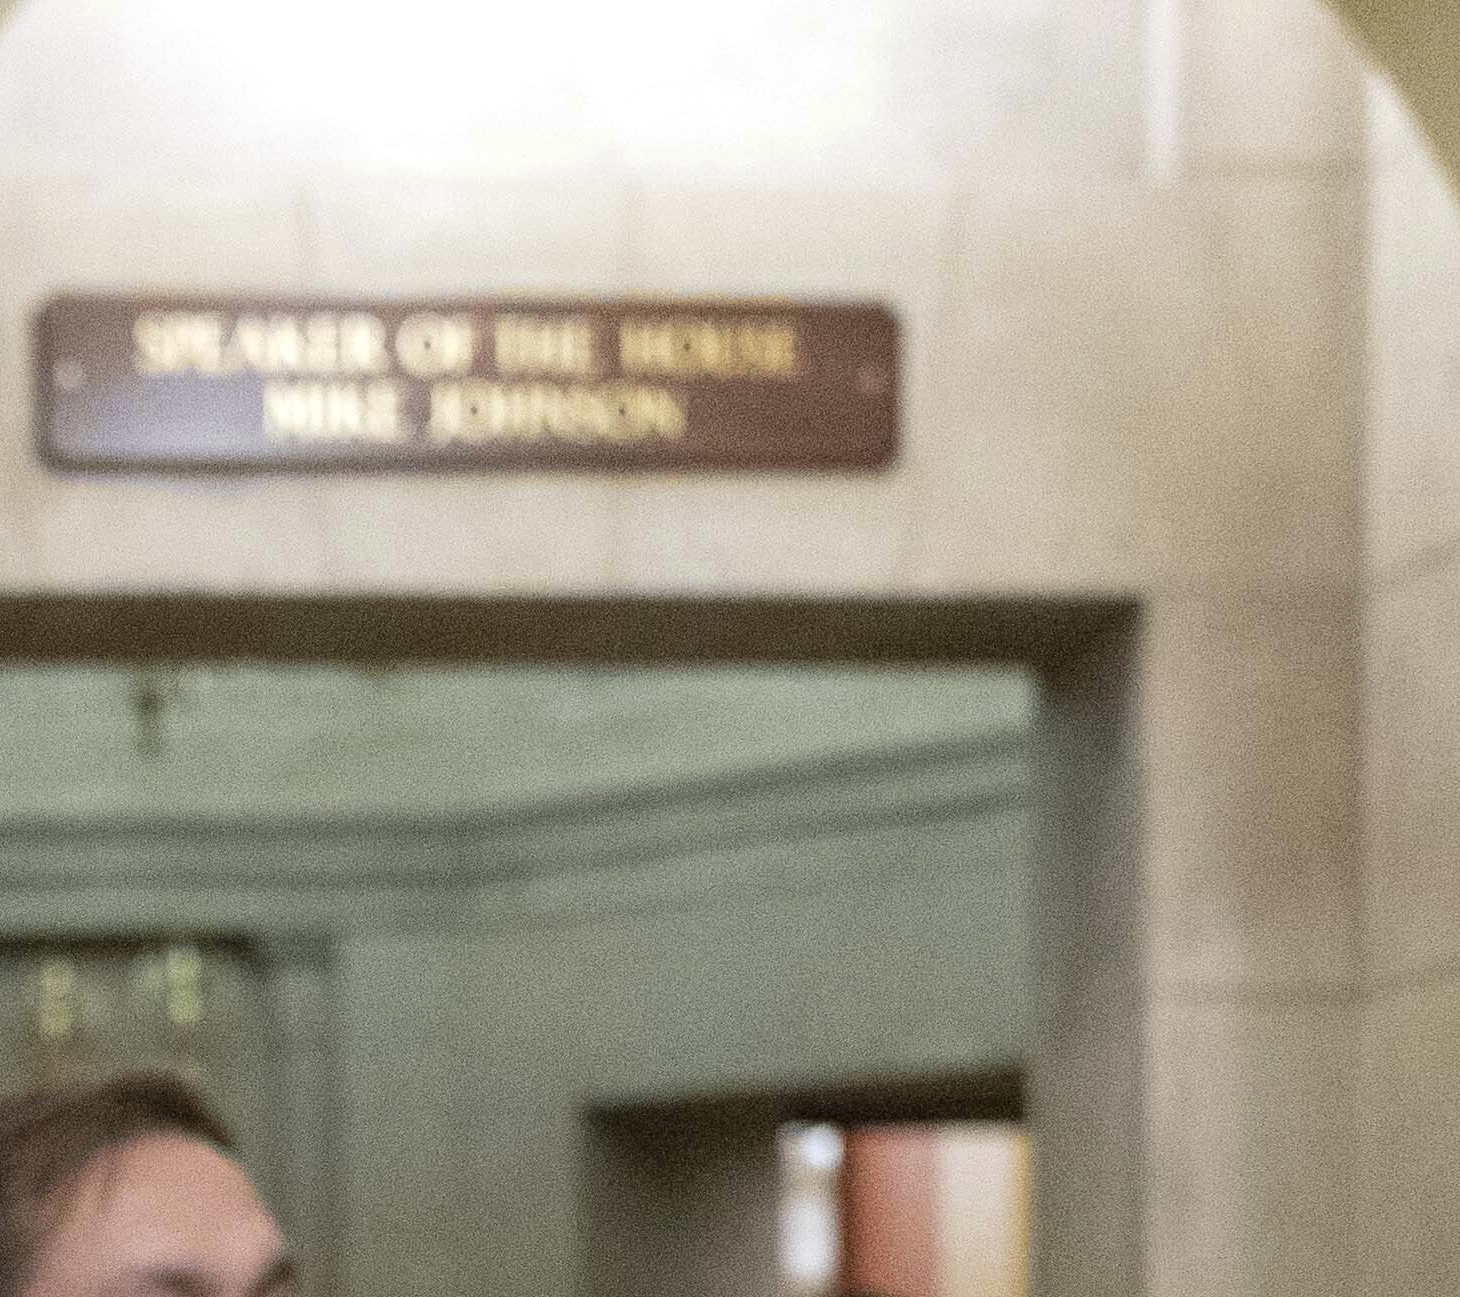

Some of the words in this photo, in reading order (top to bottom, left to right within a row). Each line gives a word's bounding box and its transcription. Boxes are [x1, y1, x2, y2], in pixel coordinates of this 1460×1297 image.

[133, 314, 386, 377] SPEAKER
[394, 314, 474, 377] OF
[493, 315, 591, 376] THE
[618, 318, 798, 378] HOUSE
[428, 382, 686, 440] JOHNSON
